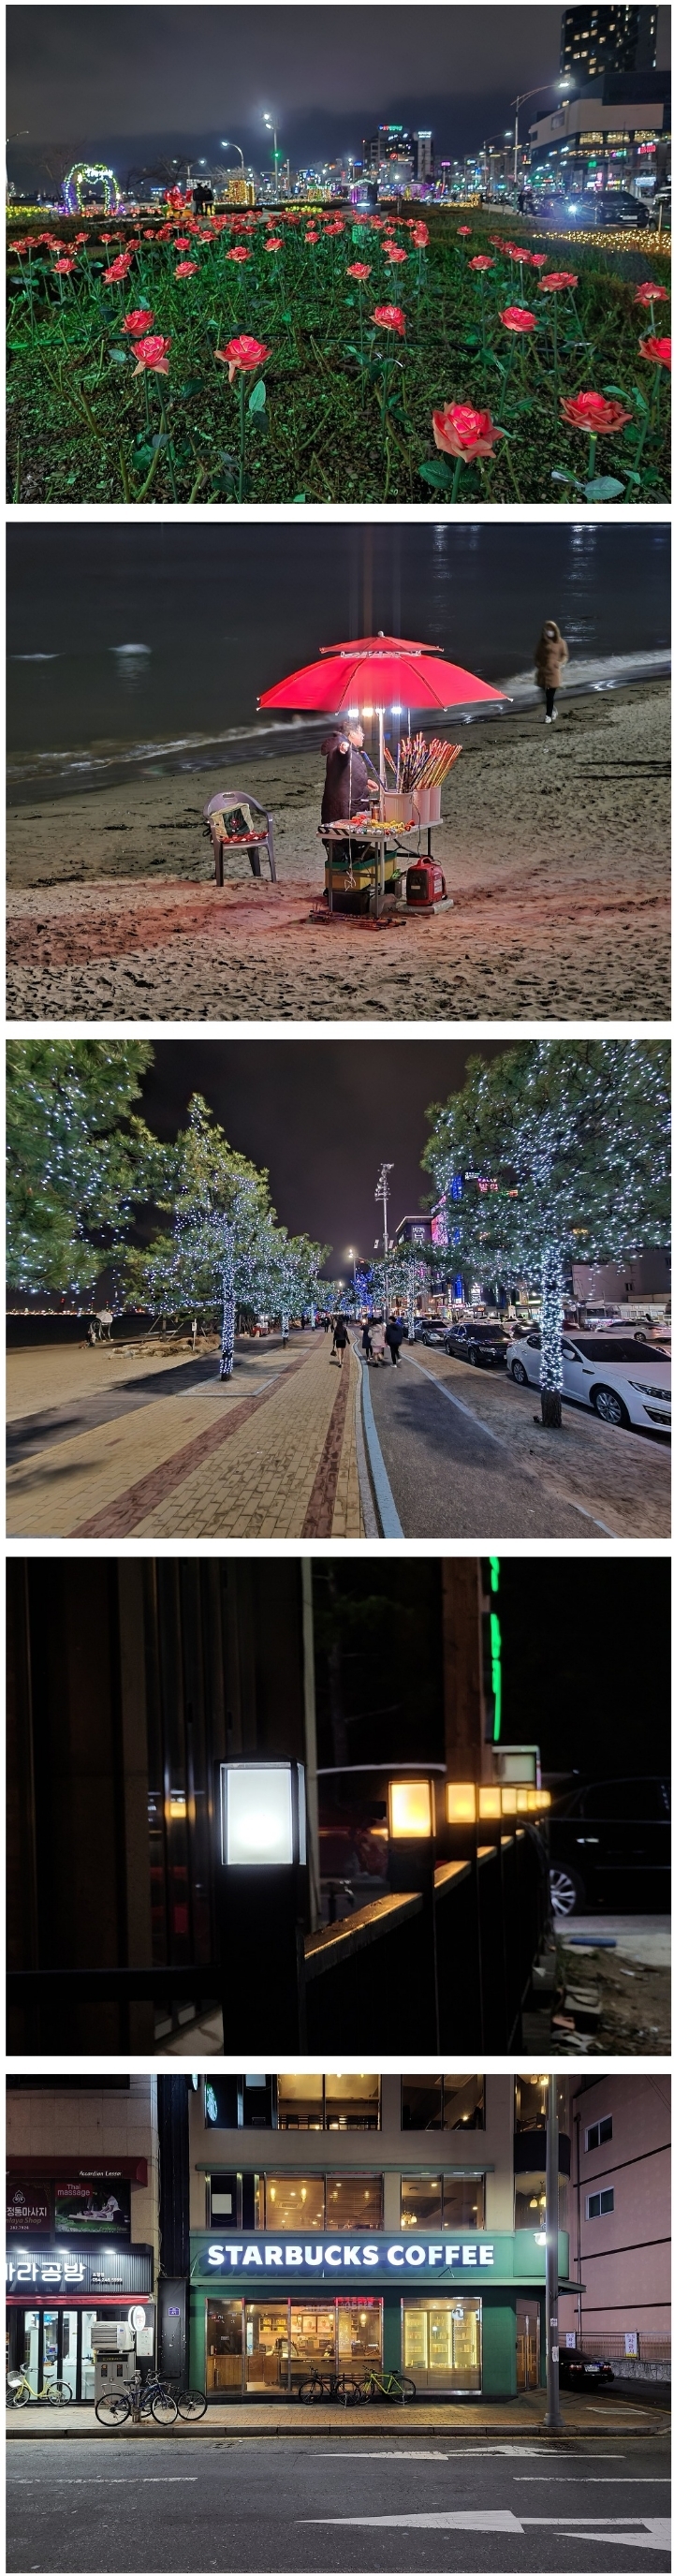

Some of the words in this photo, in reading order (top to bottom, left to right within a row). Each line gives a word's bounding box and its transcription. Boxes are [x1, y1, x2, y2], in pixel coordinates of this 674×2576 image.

[6, 2207, 47, 2217] 정동마사지
[207, 2245, 379, 2266] STARBUCKS
[387, 2245, 494, 2266] COFFEE
